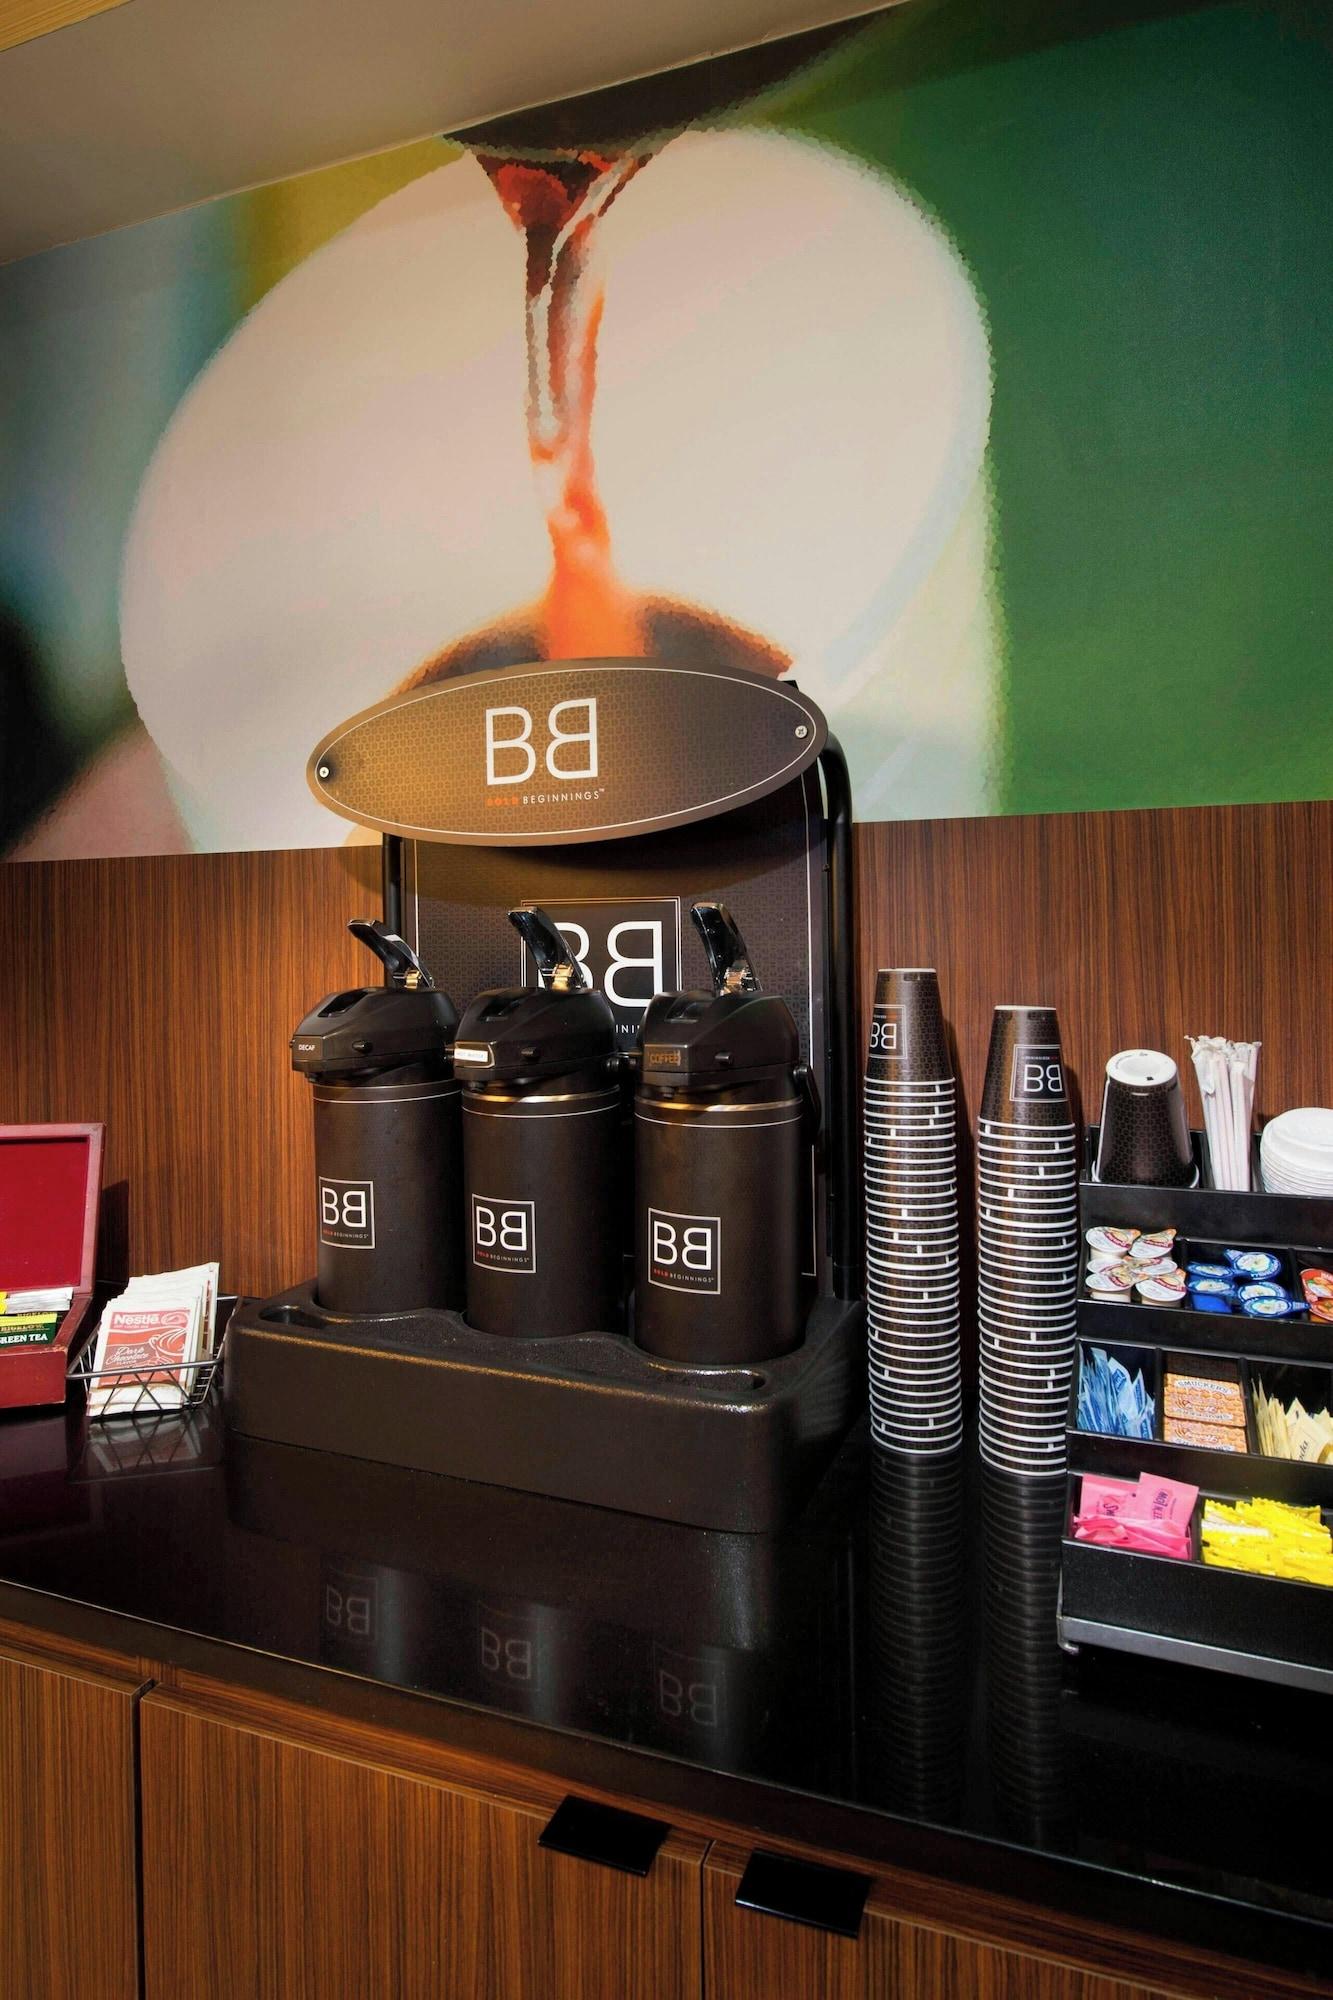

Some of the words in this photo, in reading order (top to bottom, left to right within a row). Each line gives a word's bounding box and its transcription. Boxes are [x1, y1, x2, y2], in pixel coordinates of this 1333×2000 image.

[485, 698, 599, 786] BB
[322, 1187, 367, 1228] BB
[476, 1206, 527, 1251] BB
[653, 1220, 712, 1271] BB
[28, 1333, 48, 1342] TEA
